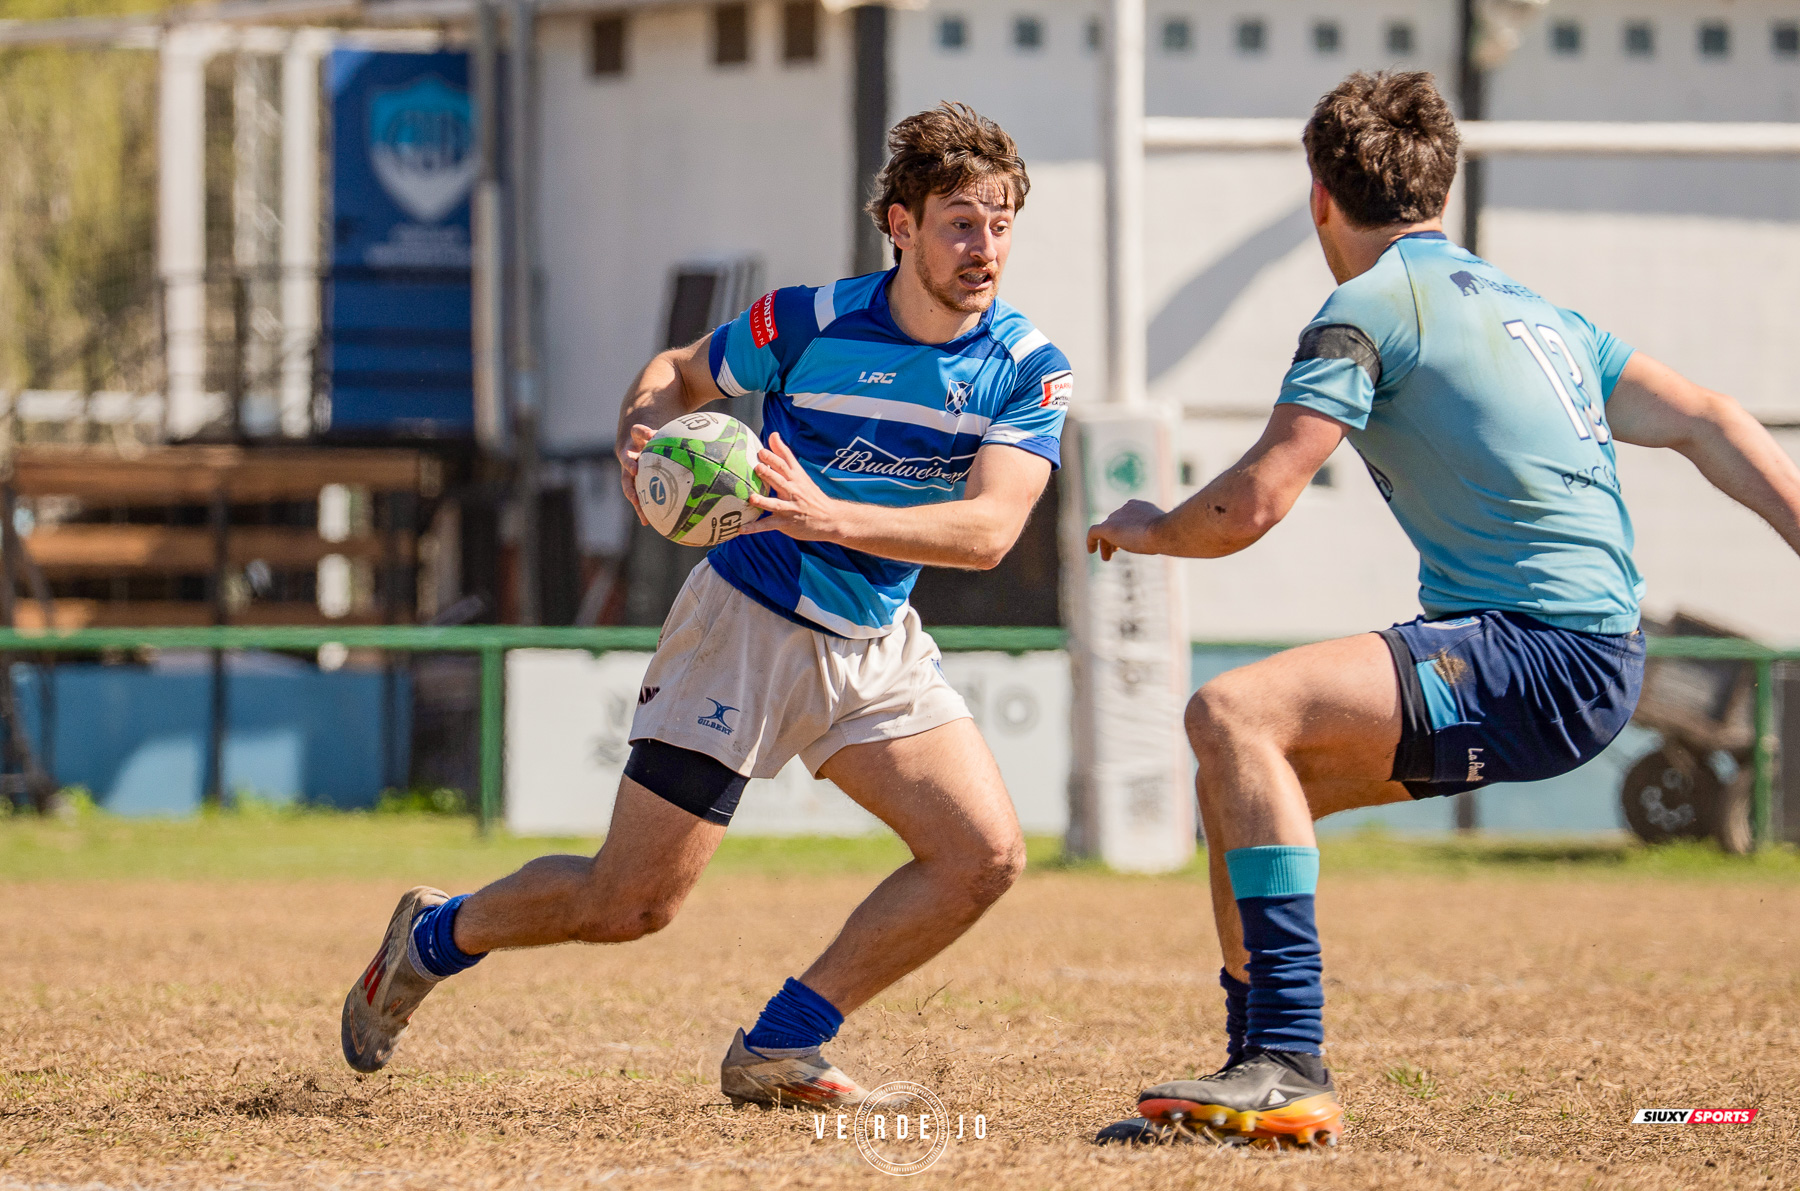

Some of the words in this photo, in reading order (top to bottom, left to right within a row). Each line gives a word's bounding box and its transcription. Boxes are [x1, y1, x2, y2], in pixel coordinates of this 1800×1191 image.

[763, 288, 775, 342] HONDA
[857, 371, 897, 384] LRC
[697, 717, 733, 735] GILBERT
